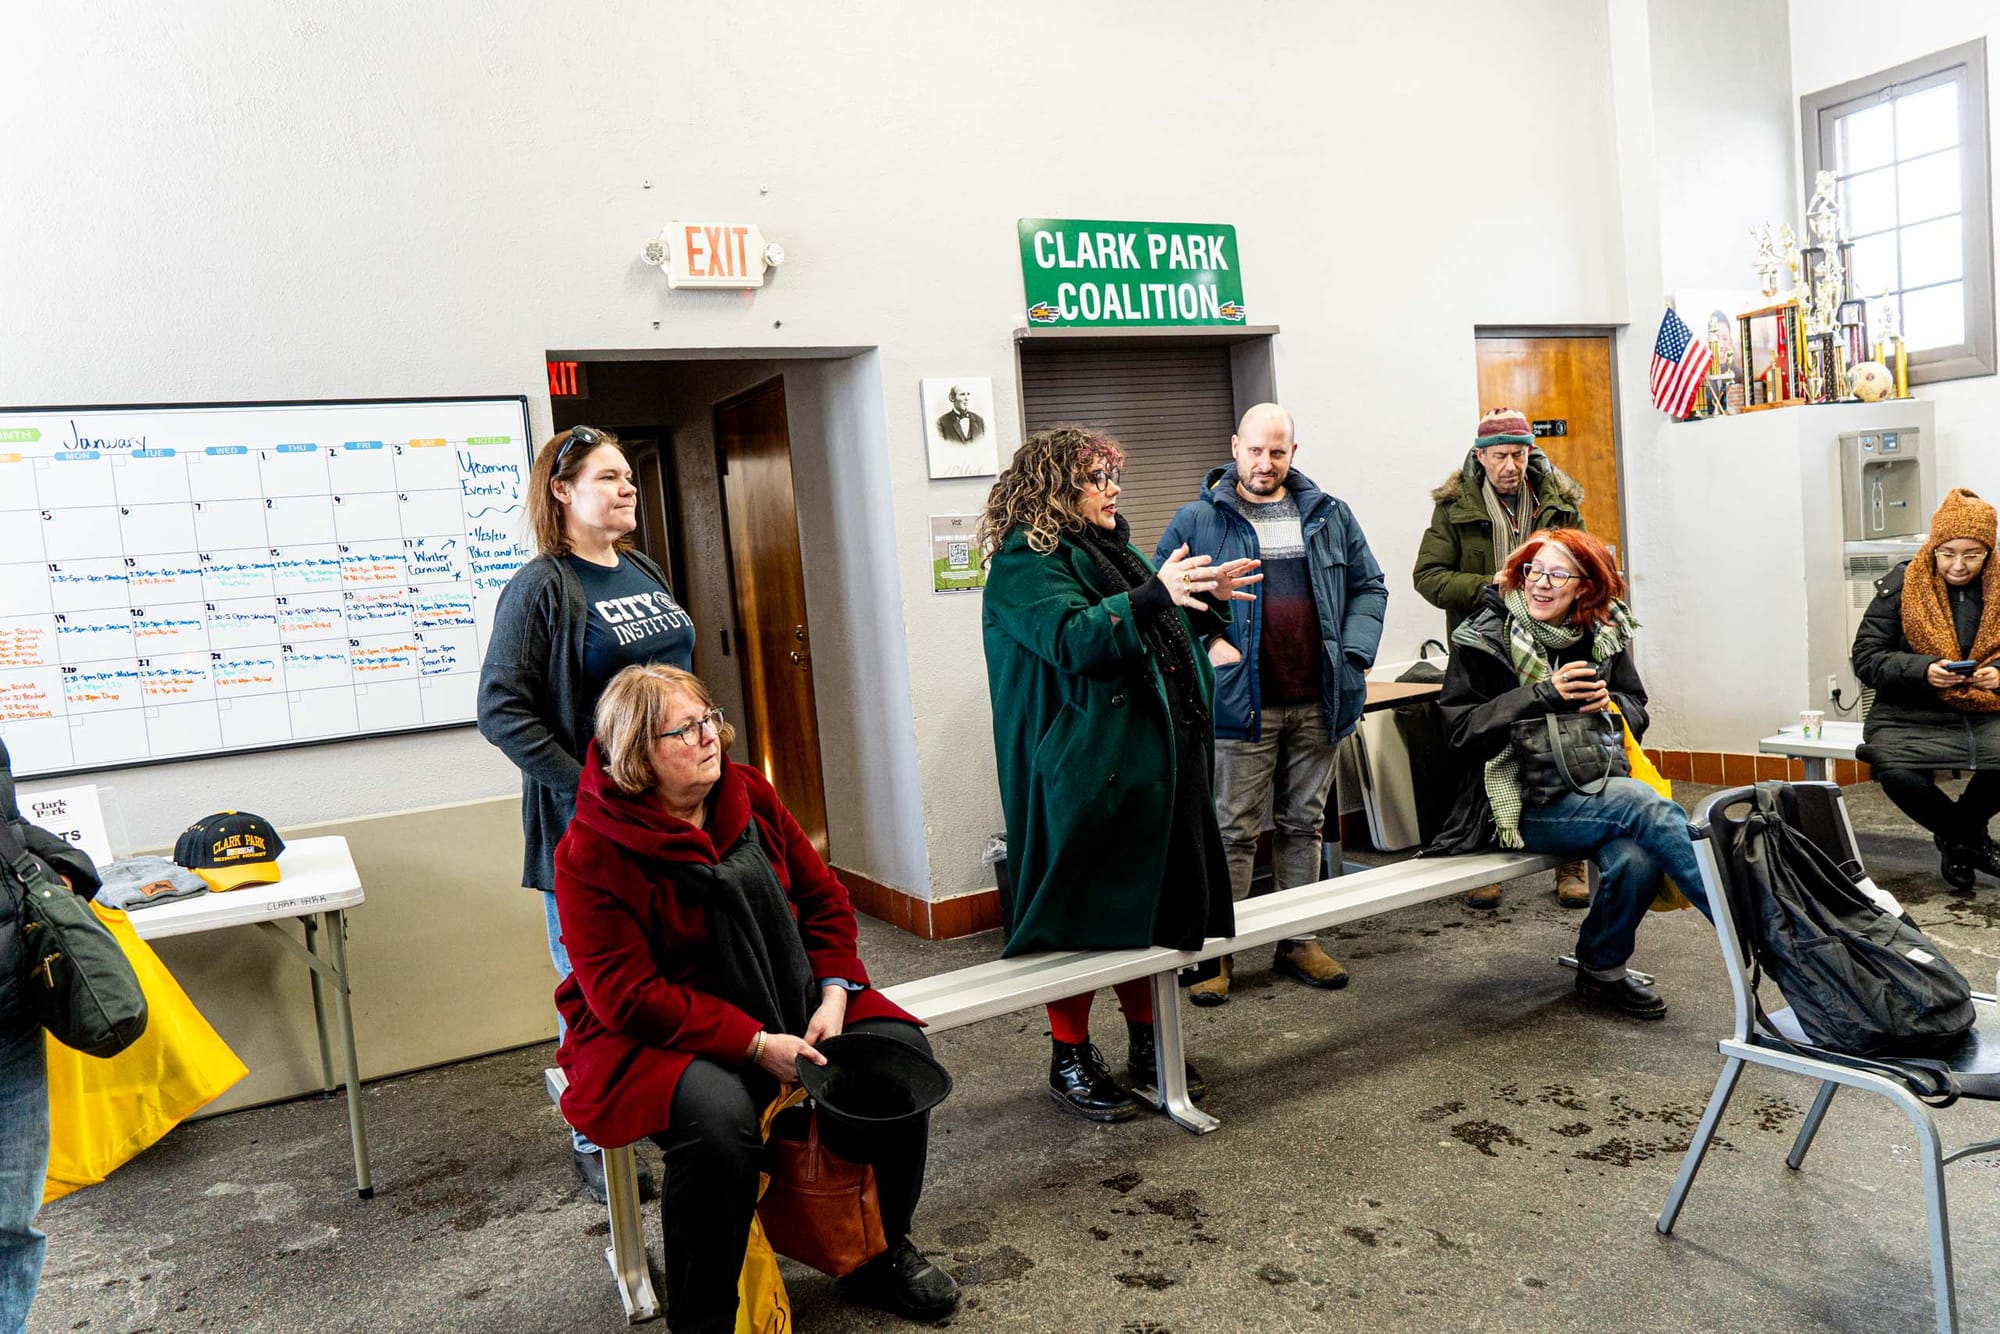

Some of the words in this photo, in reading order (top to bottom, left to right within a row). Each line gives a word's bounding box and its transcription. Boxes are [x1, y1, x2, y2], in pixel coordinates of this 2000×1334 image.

[685, 226, 748, 277] EXIT
[1034, 231, 1141, 270] CLARK
[1147, 234, 1229, 271] PARK
[1057, 283, 1221, 321] COALITION
[547, 361, 578, 396] XIT
[63, 420, 146, 451] January
[287, 444, 307, 452] THU
[356, 442, 371, 450] FRI
[394, 446, 402, 455] 3
[216, 447, 238, 455] WED
[261, 451, 266, 461] 1
[458, 451, 520, 484] Upcoming
[334, 496, 341, 504] 9
[398, 494, 408, 502] 10
[194, 503, 201, 511] 7
[41, 511, 52, 521] 5
[403, 539, 413, 548] 17
[270, 549, 280, 557] 15
[338, 545, 349, 553] 16
[494, 546, 511, 558] and
[199, 553, 212, 562] 14
[413, 550, 449, 563] Winter
[124, 558, 136, 567] 13
[48, 563, 62, 572] 12
[344, 592, 354, 600] 23
[276, 597, 288, 605] 22
[205, 603, 215, 611] 21
[595, 593, 661, 624] CITY
[130, 609, 144, 617] 20
[54, 614, 66, 623] 19
[612, 610, 694, 646] INSTITUT
[414, 632, 424, 642] 31
[348, 639, 360, 648] 30
[282, 644, 293, 653] 29
[138, 658, 150, 667] 27
[32, 800, 67, 811] Clark
[36, 808, 66, 818] Park
[212, 834, 242, 855] CLARK
[244, 834, 266, 850] PARK
